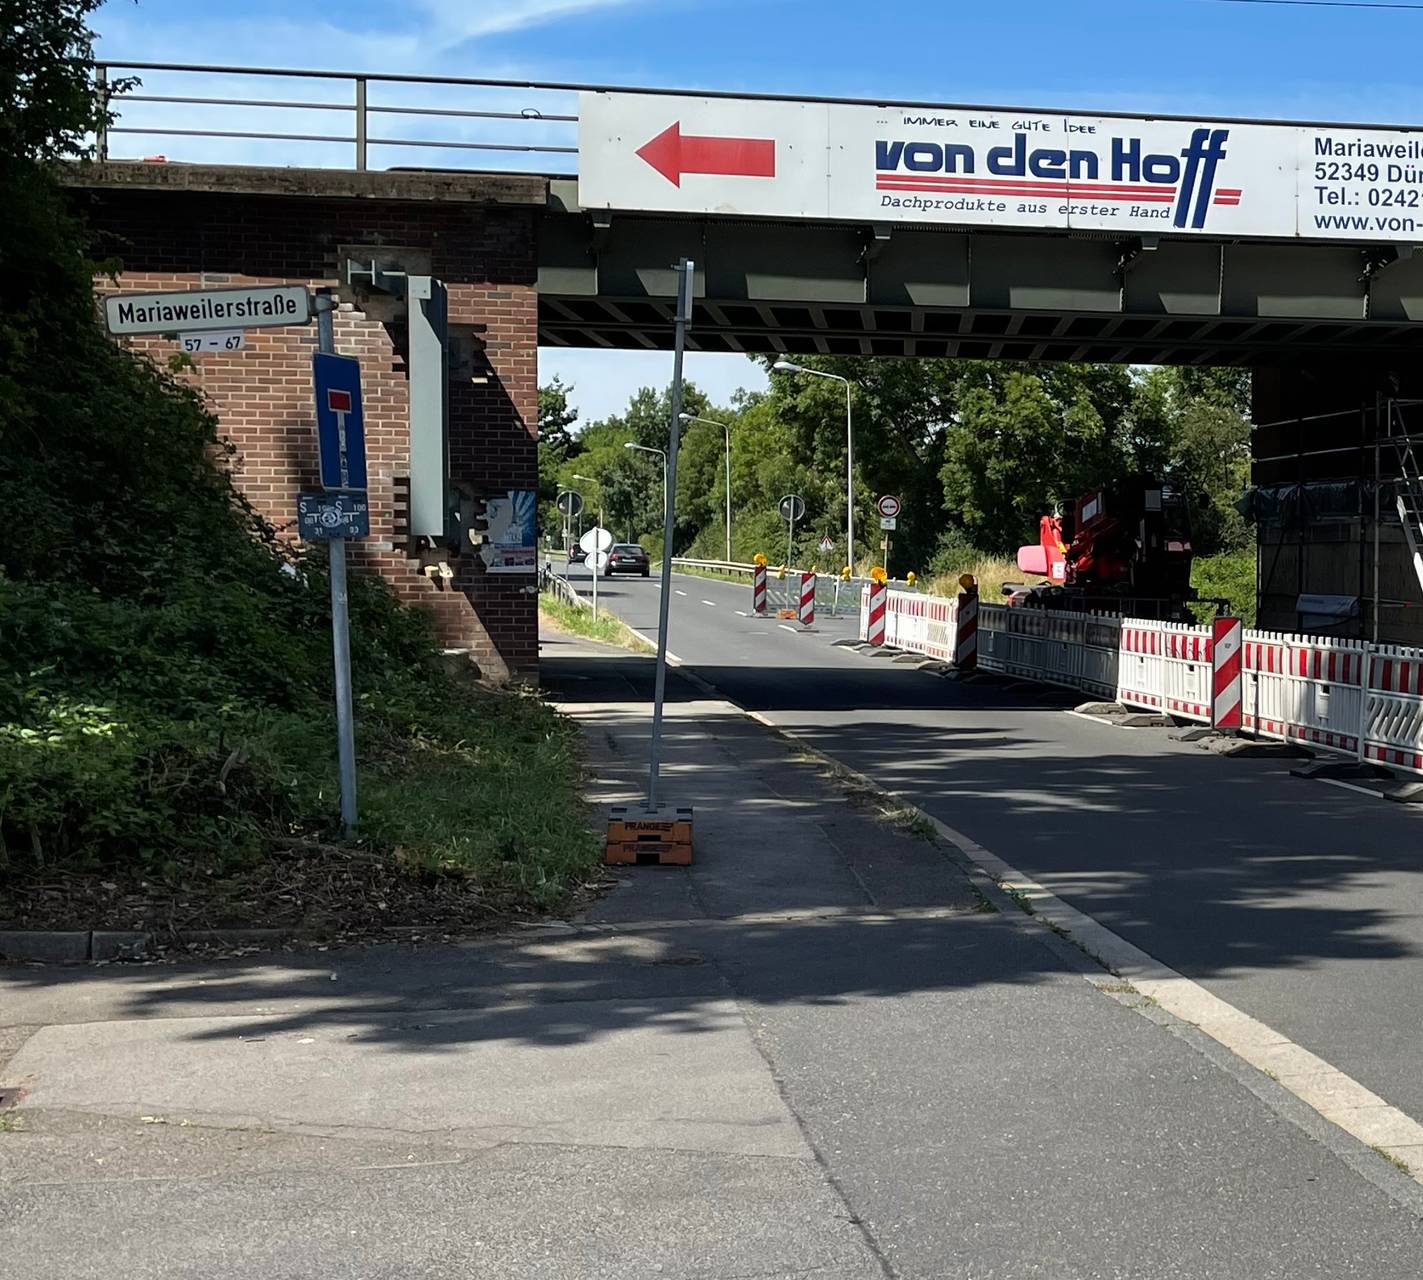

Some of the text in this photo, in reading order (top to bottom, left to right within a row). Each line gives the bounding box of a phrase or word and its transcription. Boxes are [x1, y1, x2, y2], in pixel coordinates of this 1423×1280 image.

[903, 116, 958, 128] IMMER
[969, 119, 1000, 129] EINE
[1011, 119, 1051, 132] GUTE
[875, 128, 1230, 229] von den Hoff
[1314, 162, 1379, 182] 52349
[1314, 186, 1360, 206] Tel.:
[881, 195, 1171, 219] Dachprodukte aus erster Hand
[118, 294, 297, 324] Mariaweilerstraße
[184, 338, 202, 352] 57
[225, 336, 241, 350] 67
[353, 503, 367, 511] 100
